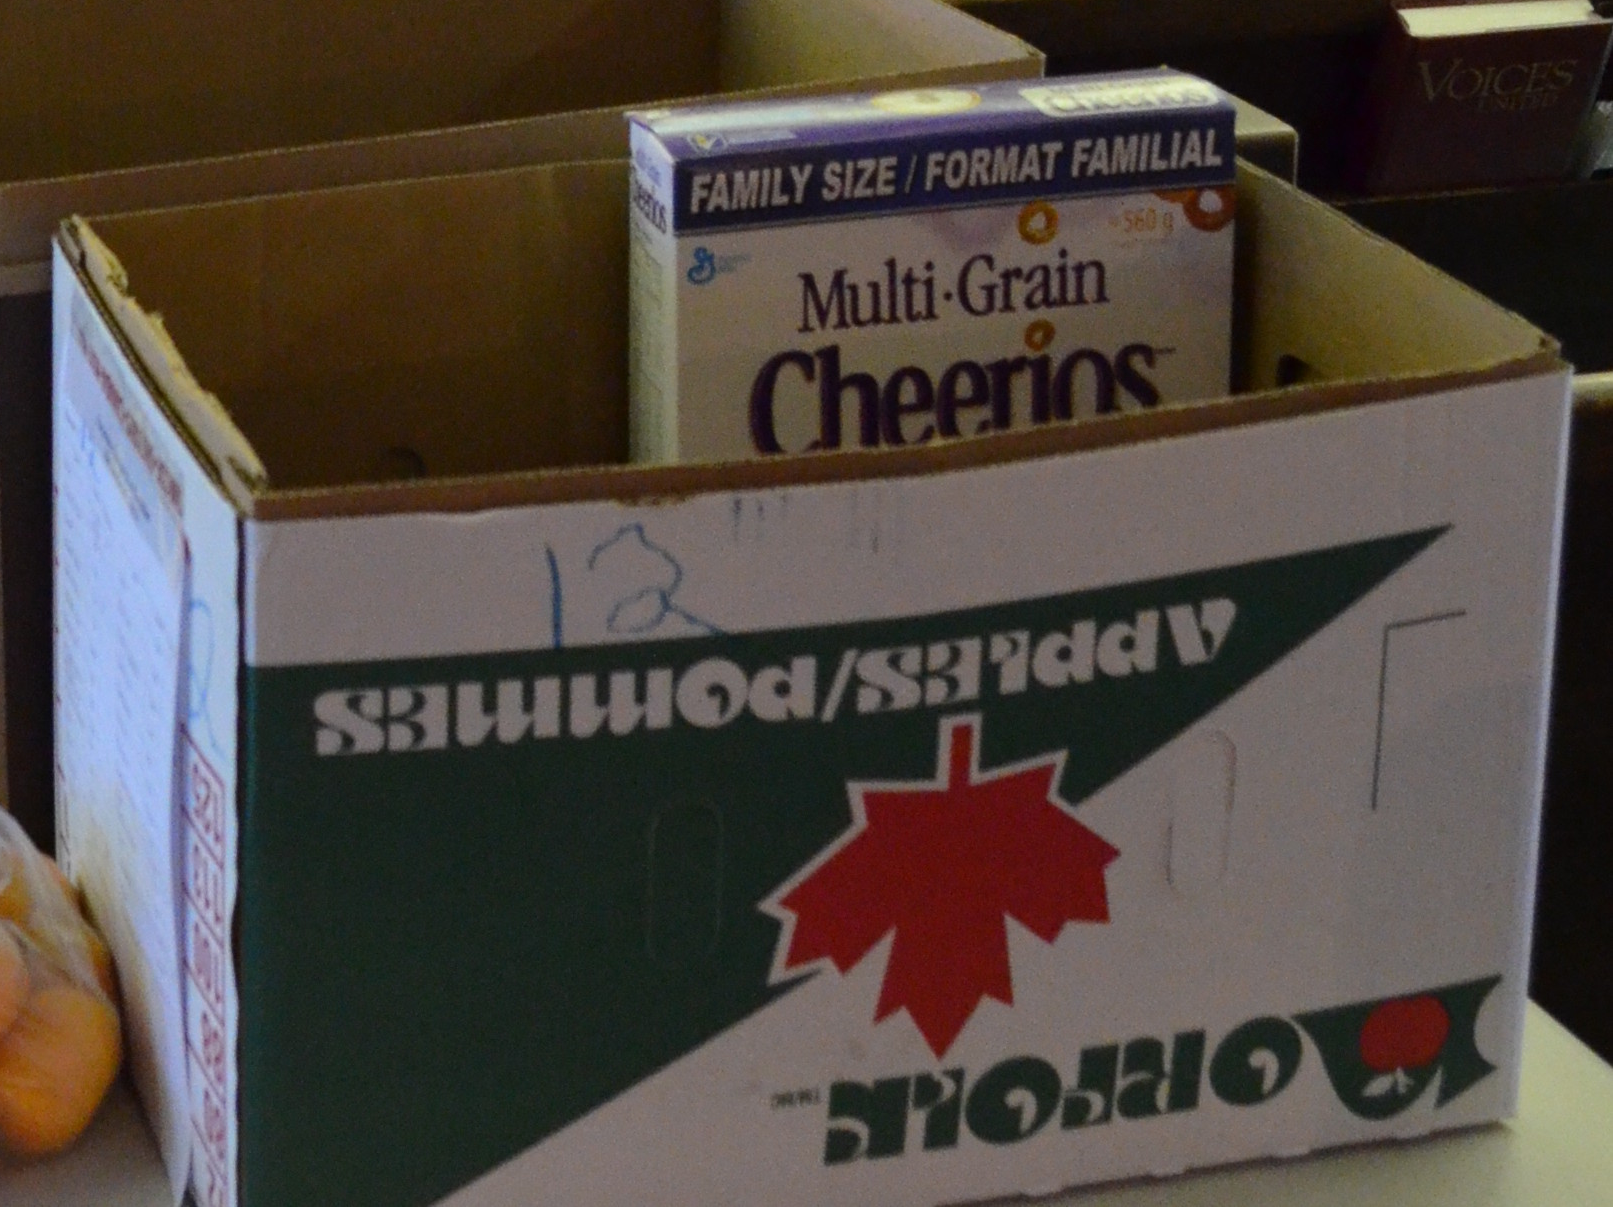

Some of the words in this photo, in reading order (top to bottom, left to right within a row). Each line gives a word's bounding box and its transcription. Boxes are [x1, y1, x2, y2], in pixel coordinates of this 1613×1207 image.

[1417, 56, 1579, 103] VOICES
[689, 163, 814, 215] FAMILY
[821, 155, 899, 203] SIZE
[924, 141, 1064, 192] FORMAT
[1070, 129, 1224, 179] FAMILIAL
[749, 343, 1161, 454] Cheerios
[544, 522, 728, 650] 12
